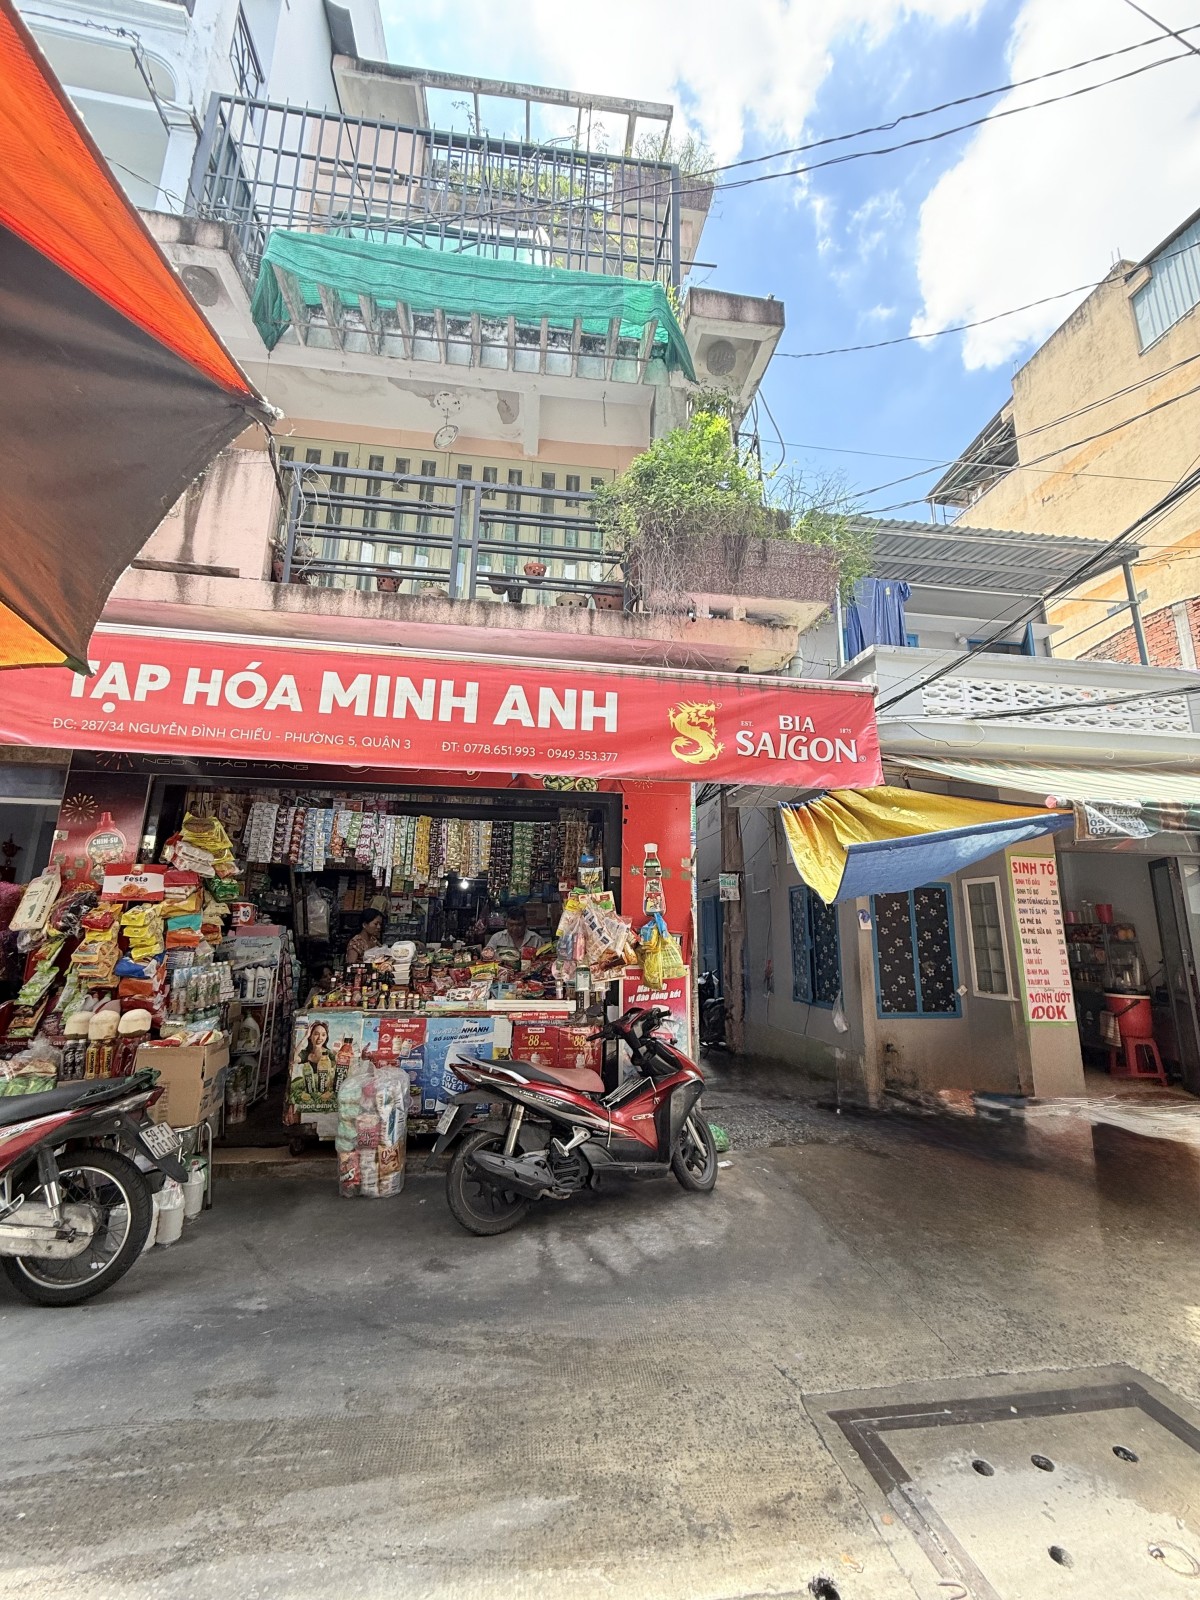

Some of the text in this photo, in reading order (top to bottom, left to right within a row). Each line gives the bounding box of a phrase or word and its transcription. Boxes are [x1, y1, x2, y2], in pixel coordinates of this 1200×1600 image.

[70, 660, 618, 733] TẠP HÓA MINH ANH
[53, 718, 77, 730] ĐC:
[81, 719, 125, 732] 287/34
[128, 720, 187, 736] NGUYỄN
[191, 723, 226, 738] ĐÌNH
[284, 731, 344, 746] PHƯỜNG
[347, 736, 357, 747] 5,
[361, 735, 400, 751] QUẬN
[404, 739, 411, 749] 3
[778, 715, 815, 733] BIA
[441, 741, 460, 752] ĐT:
[463, 743, 536, 757] 0778.651.993
[547, 748, 618, 762] 0949.353.377
[736, 731, 858, 763] SAIGON
[1012, 860, 1054, 875] SINH TỐ
[461, 1026, 489, 1034] NHANH
